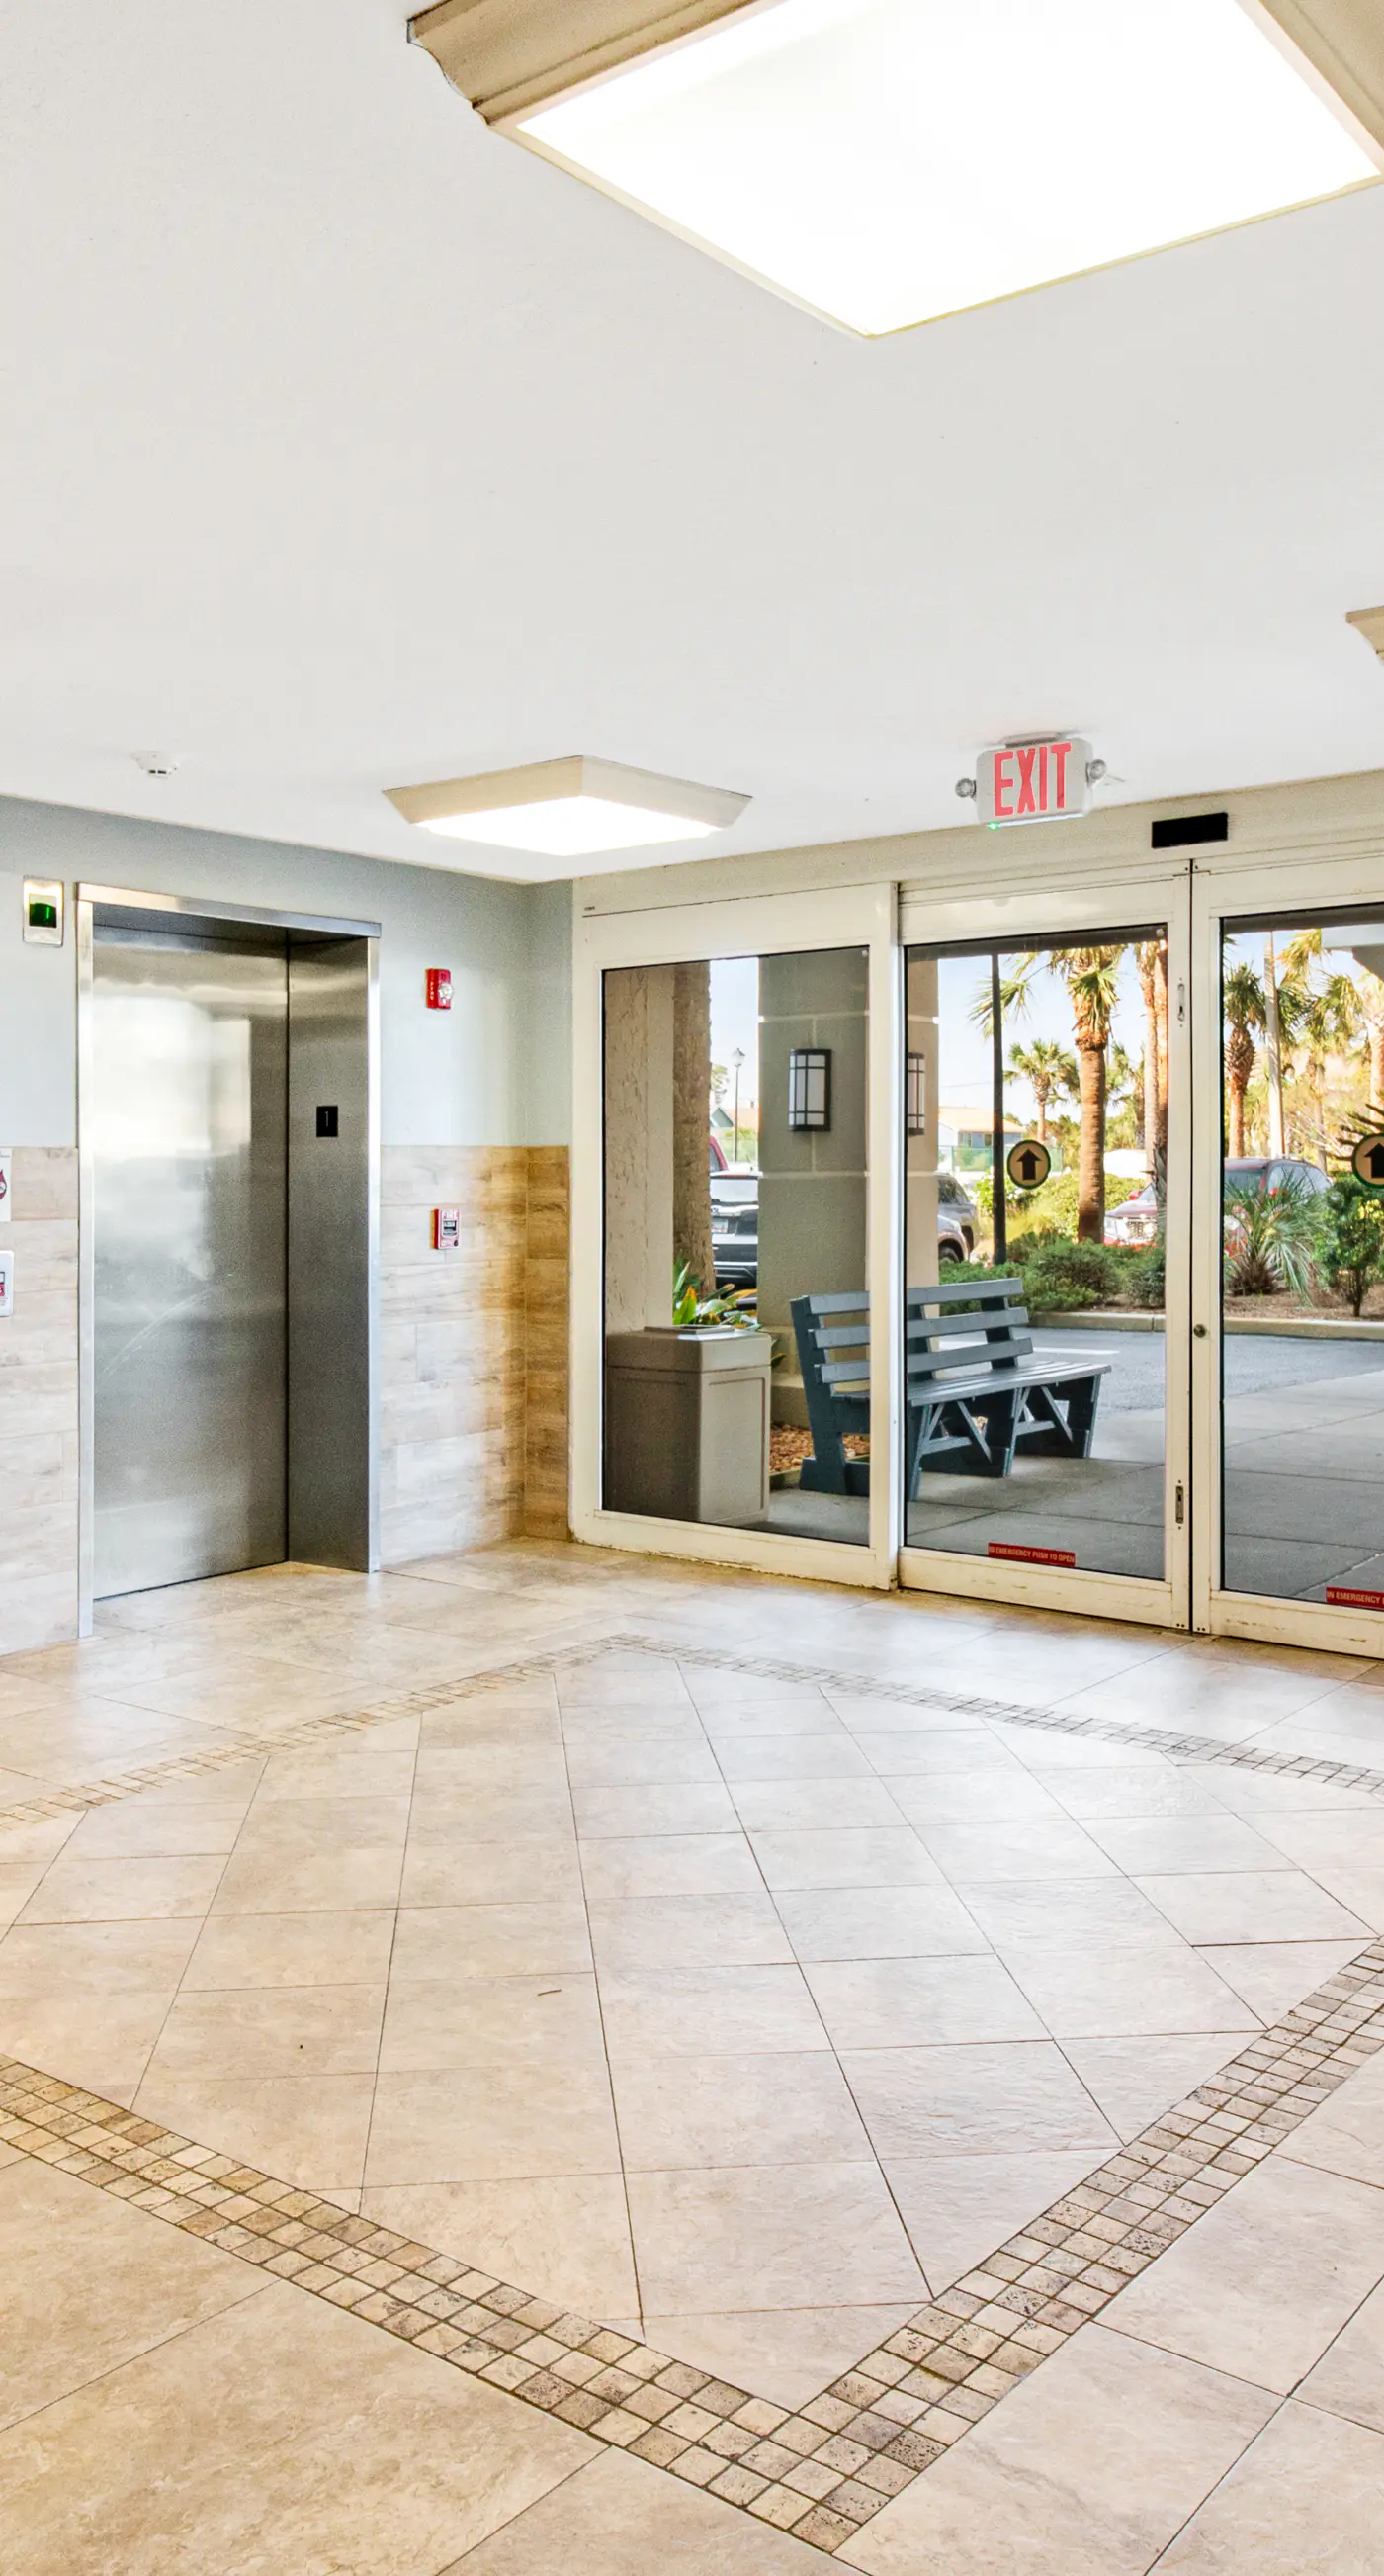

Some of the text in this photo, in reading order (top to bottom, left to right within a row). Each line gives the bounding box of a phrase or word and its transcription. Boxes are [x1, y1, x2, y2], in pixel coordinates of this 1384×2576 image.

[994, 742, 1072, 817] EXIT
[324, 1110, 329, 1127] 1
[441, 1208, 458, 1219] FIRE
[995, 1546, 1032, 1557] EMERGENCY
[1032, 1551, 1049, 1559] PUSH
[1058, 1554, 1075, 1563] OPEN
[1327, 1590, 1335, 1599] IN
[1336, 1592, 1381, 1604] EMERGENCY
